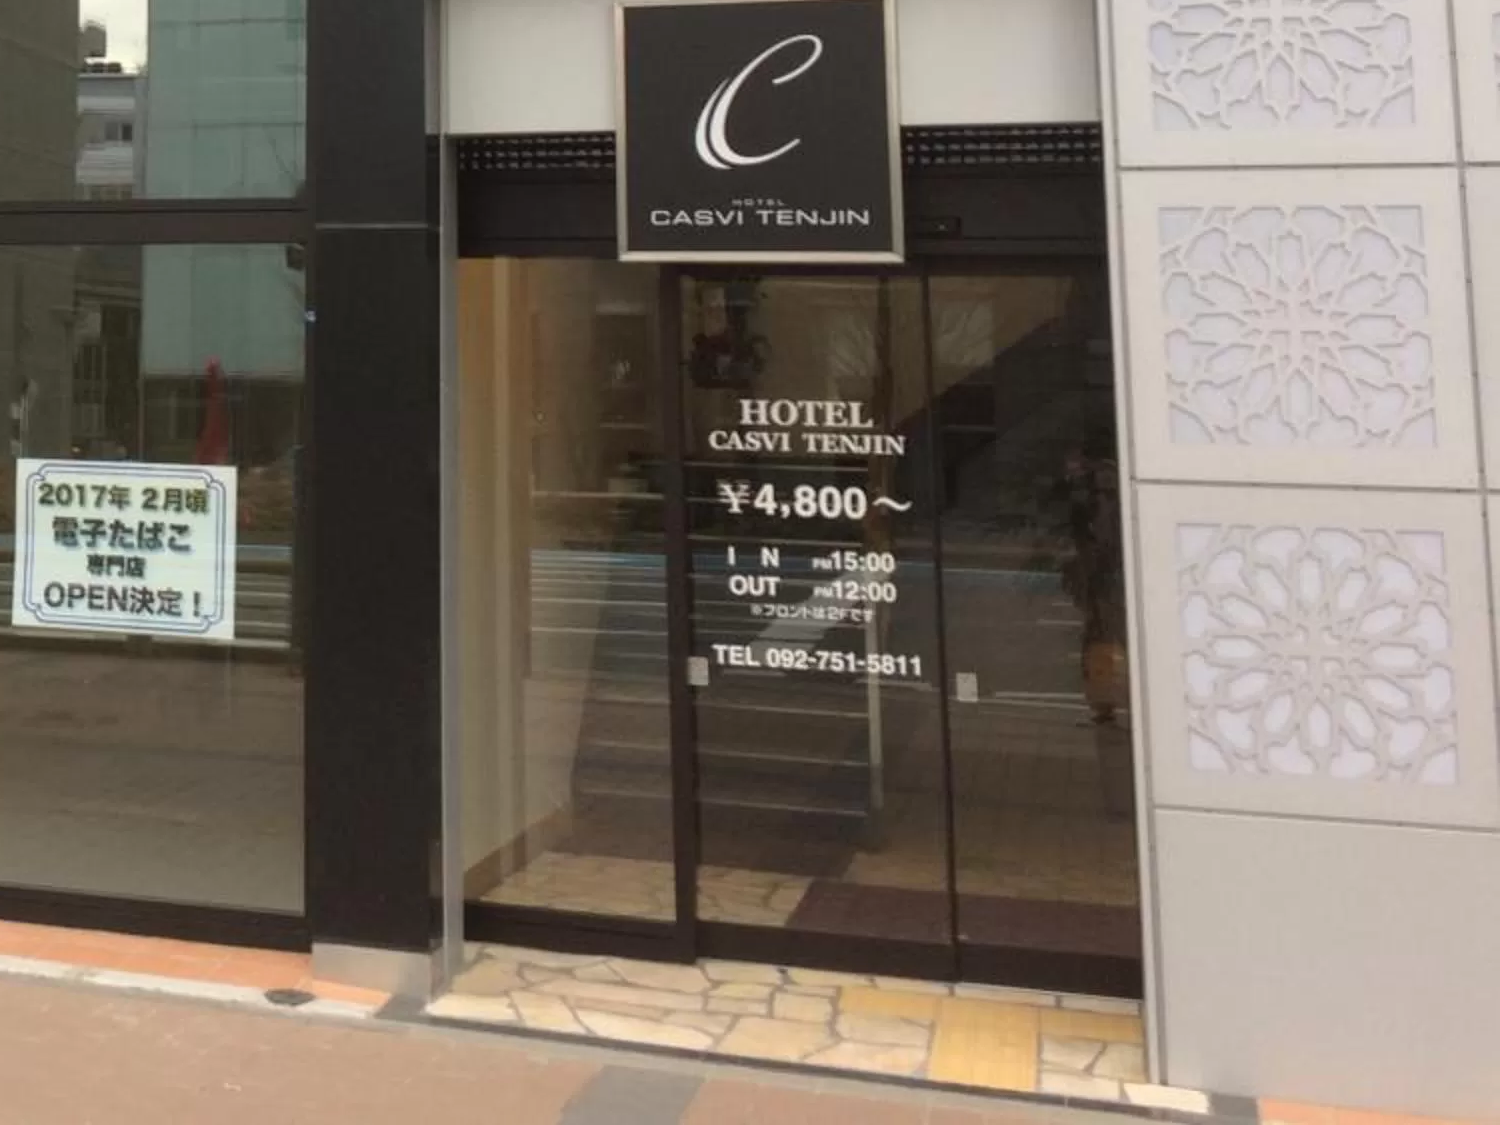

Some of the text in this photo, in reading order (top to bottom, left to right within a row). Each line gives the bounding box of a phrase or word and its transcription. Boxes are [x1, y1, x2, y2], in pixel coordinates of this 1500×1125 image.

[649, 209, 870, 225] CASVI TENJIN
[739, 398, 874, 428] HOTEL
[708, 430, 906, 457] CASVI TENJIN
[52, 516, 192, 552] 電子たばこ
[86, 554, 146, 578] 専門店
[729, 575, 781, 596] OUT
[712, 643, 922, 676] TEL 092-751-5811
